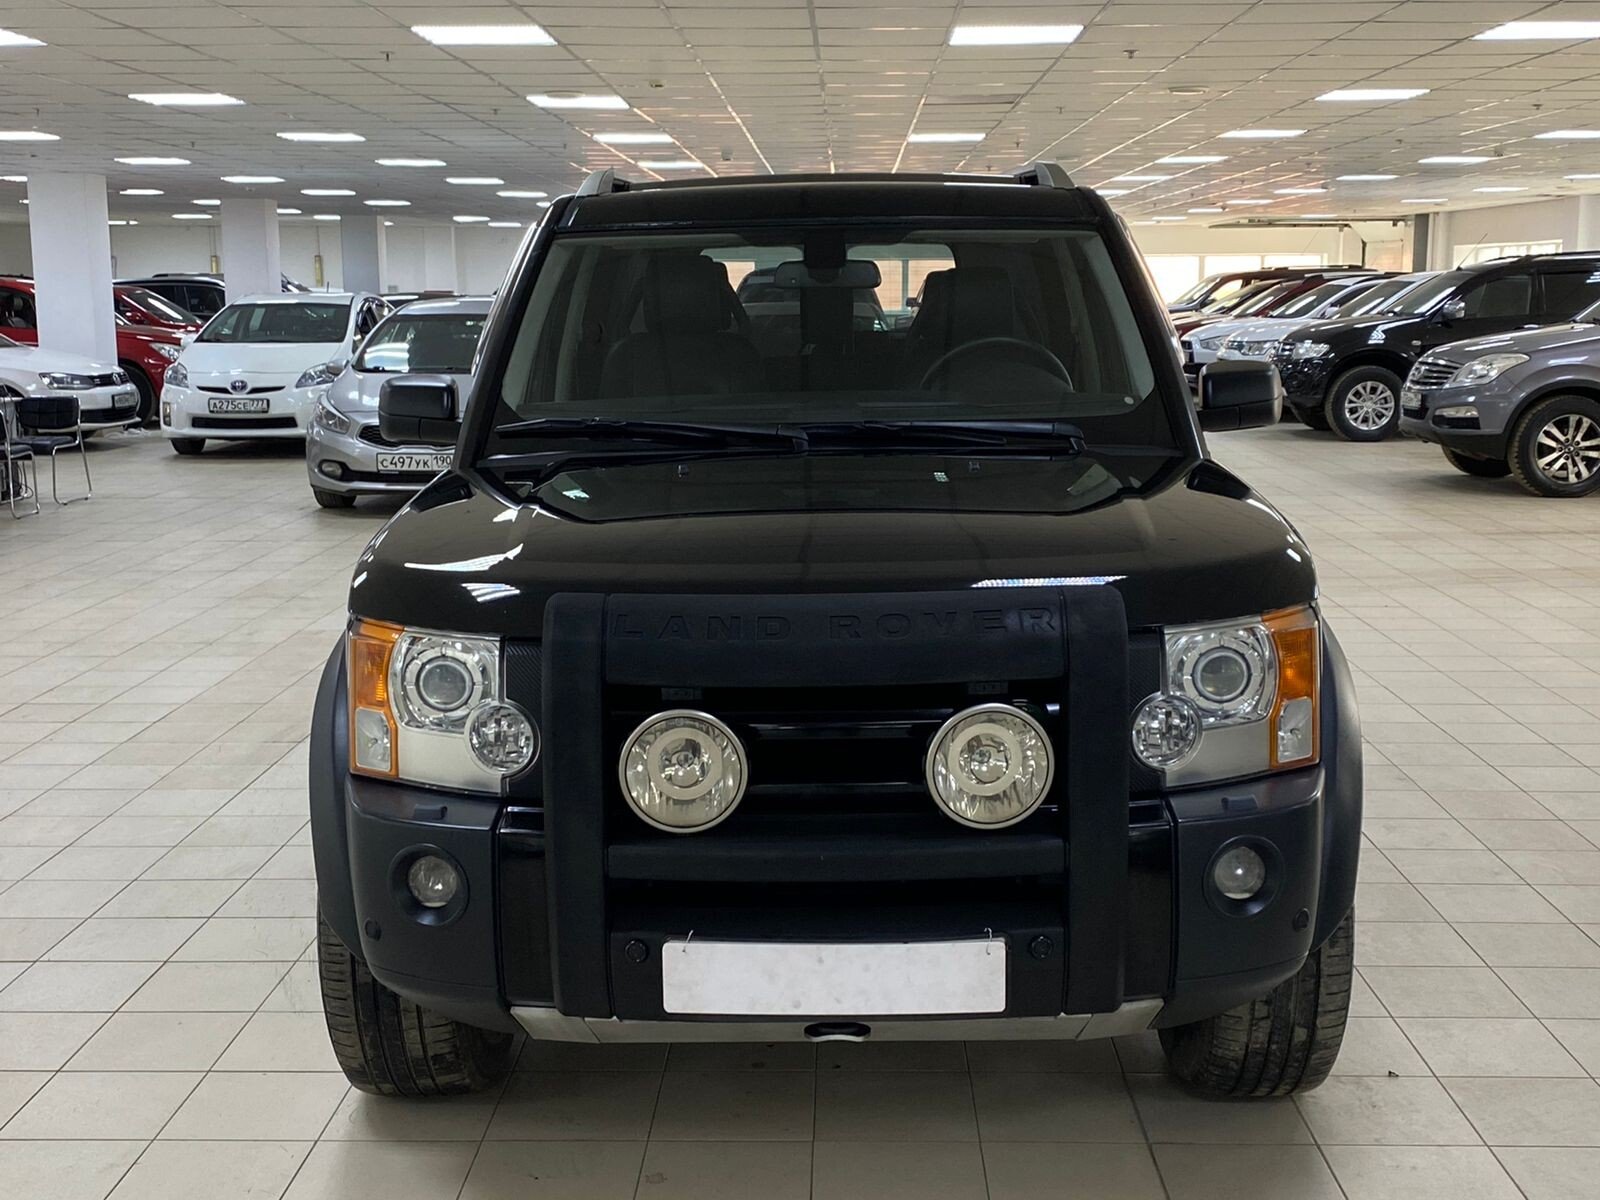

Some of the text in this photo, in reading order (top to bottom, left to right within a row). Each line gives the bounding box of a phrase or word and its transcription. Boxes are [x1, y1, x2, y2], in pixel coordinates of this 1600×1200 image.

[433, 455, 452, 466] 190
[613, 607, 1057, 641] LAND ROVER
